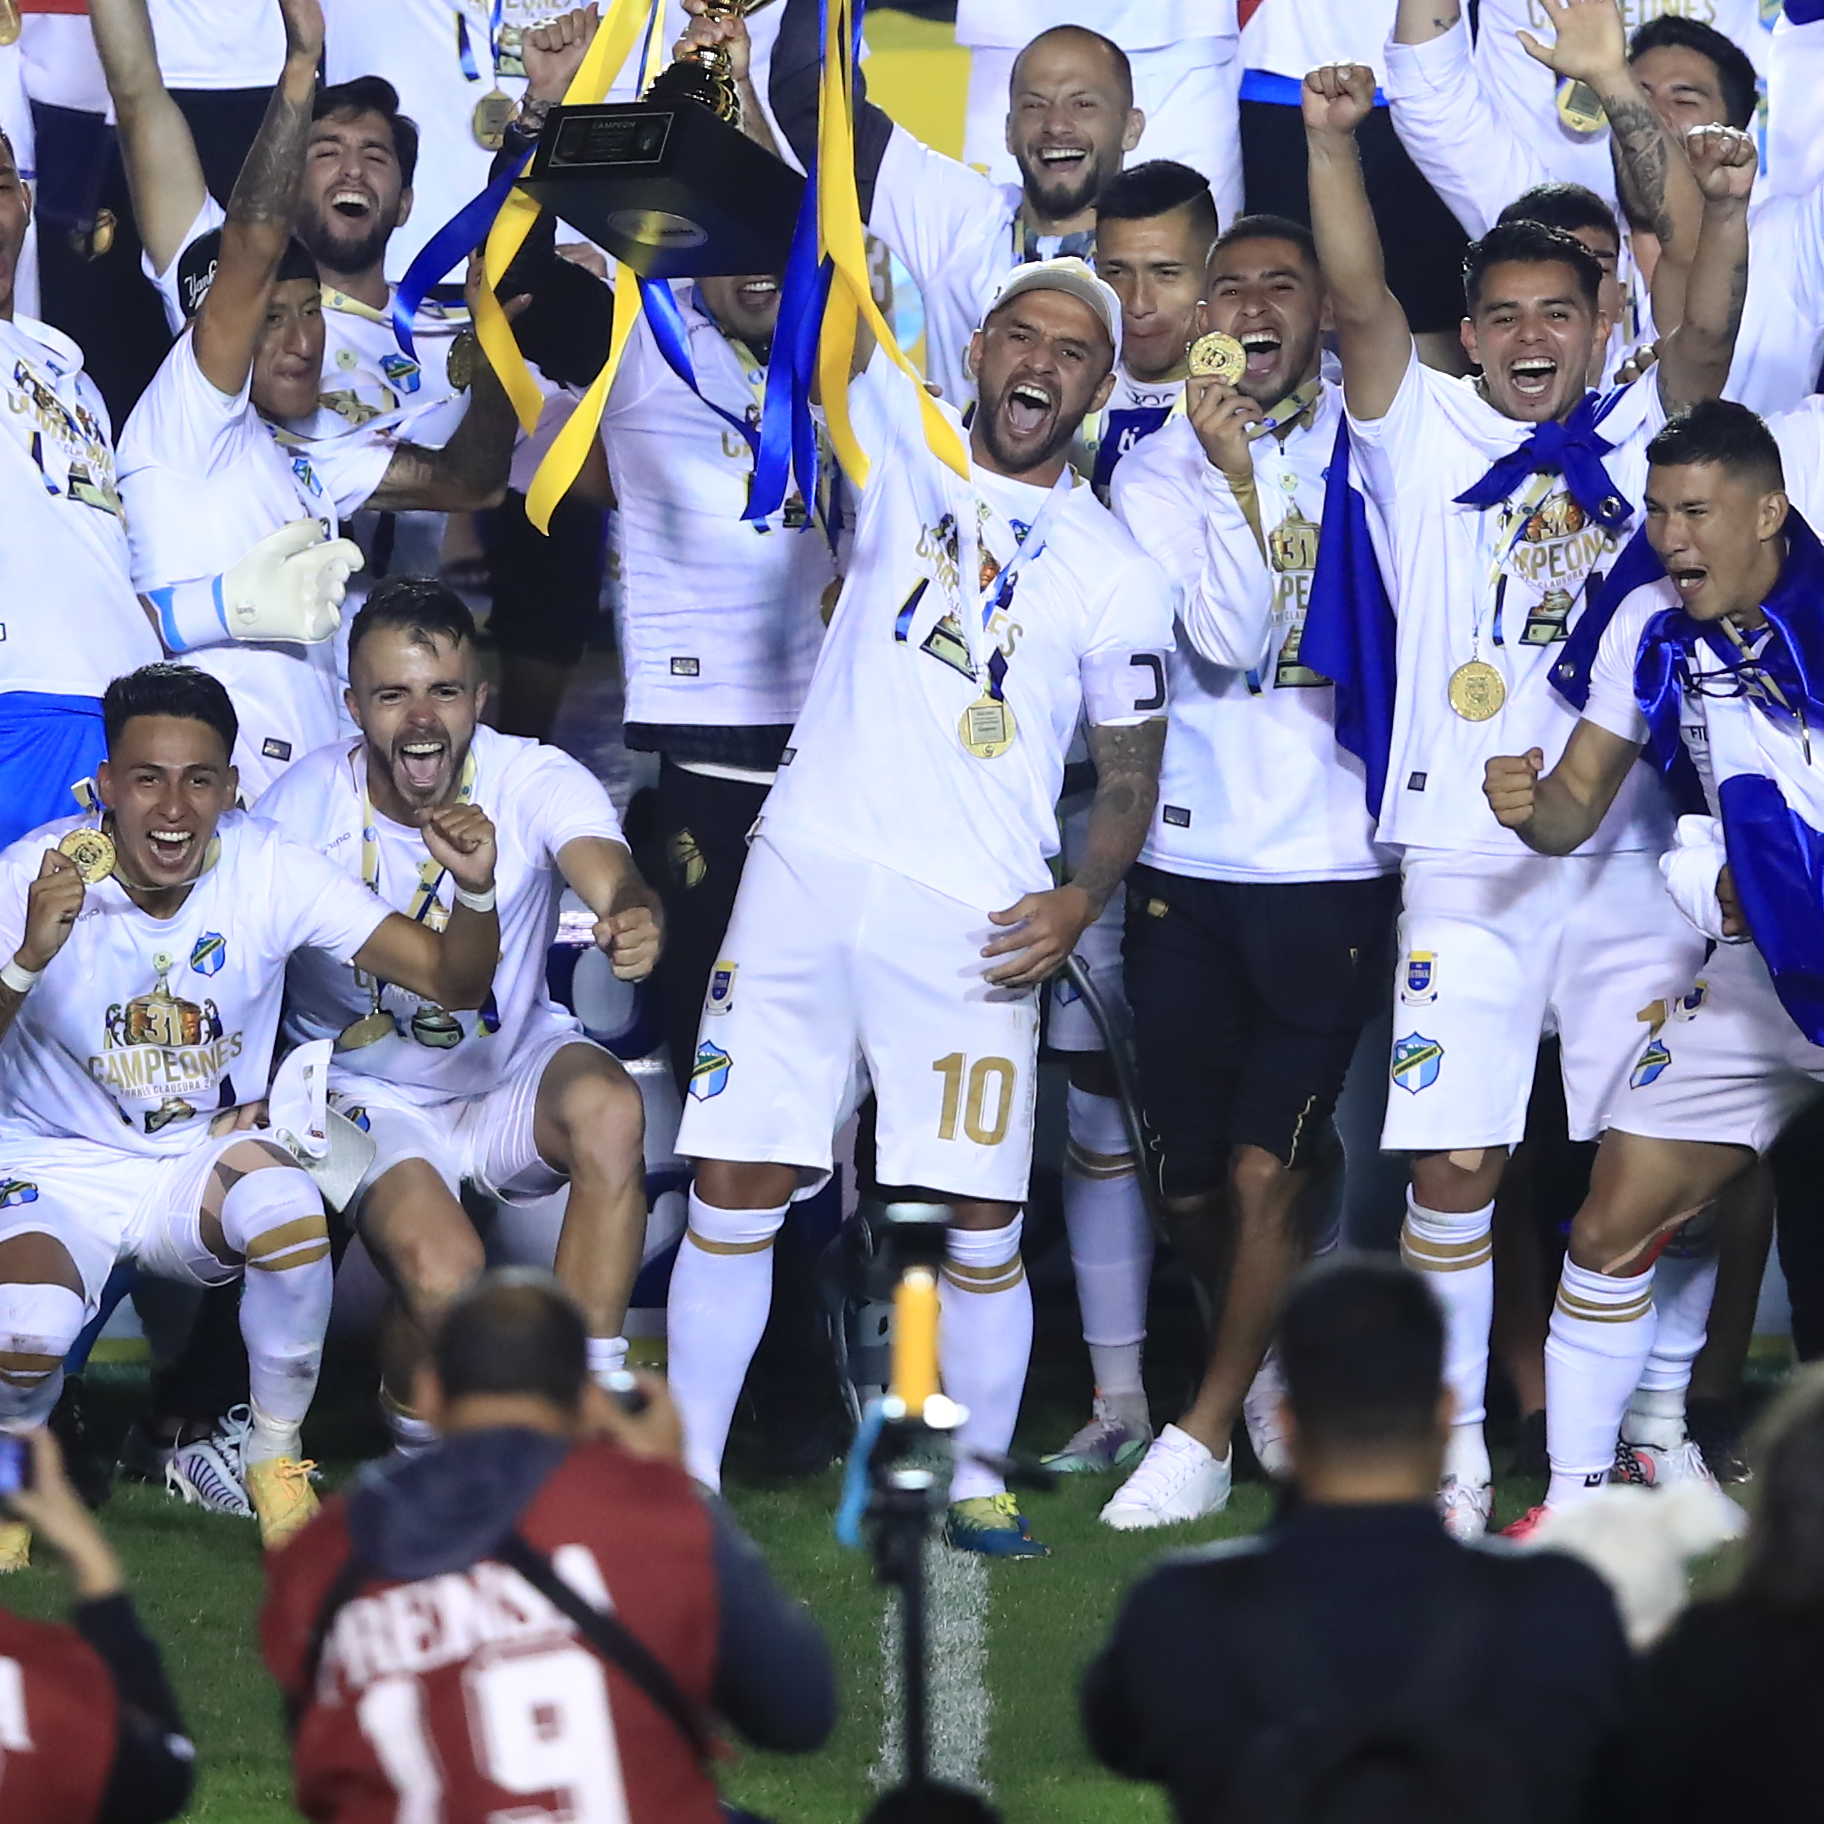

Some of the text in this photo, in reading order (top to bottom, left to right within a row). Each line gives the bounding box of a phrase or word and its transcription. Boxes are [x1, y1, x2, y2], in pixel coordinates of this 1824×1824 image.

[87, 1031, 244, 1087] CAMPEONES
[143, 1002, 181, 1050] 31
[153, 1078, 199, 1094] CLAUSURA
[933, 1052, 1018, 1147] 10
[316, 1544, 616, 1706] PRENSA
[358, 1646, 634, 1824] 19
